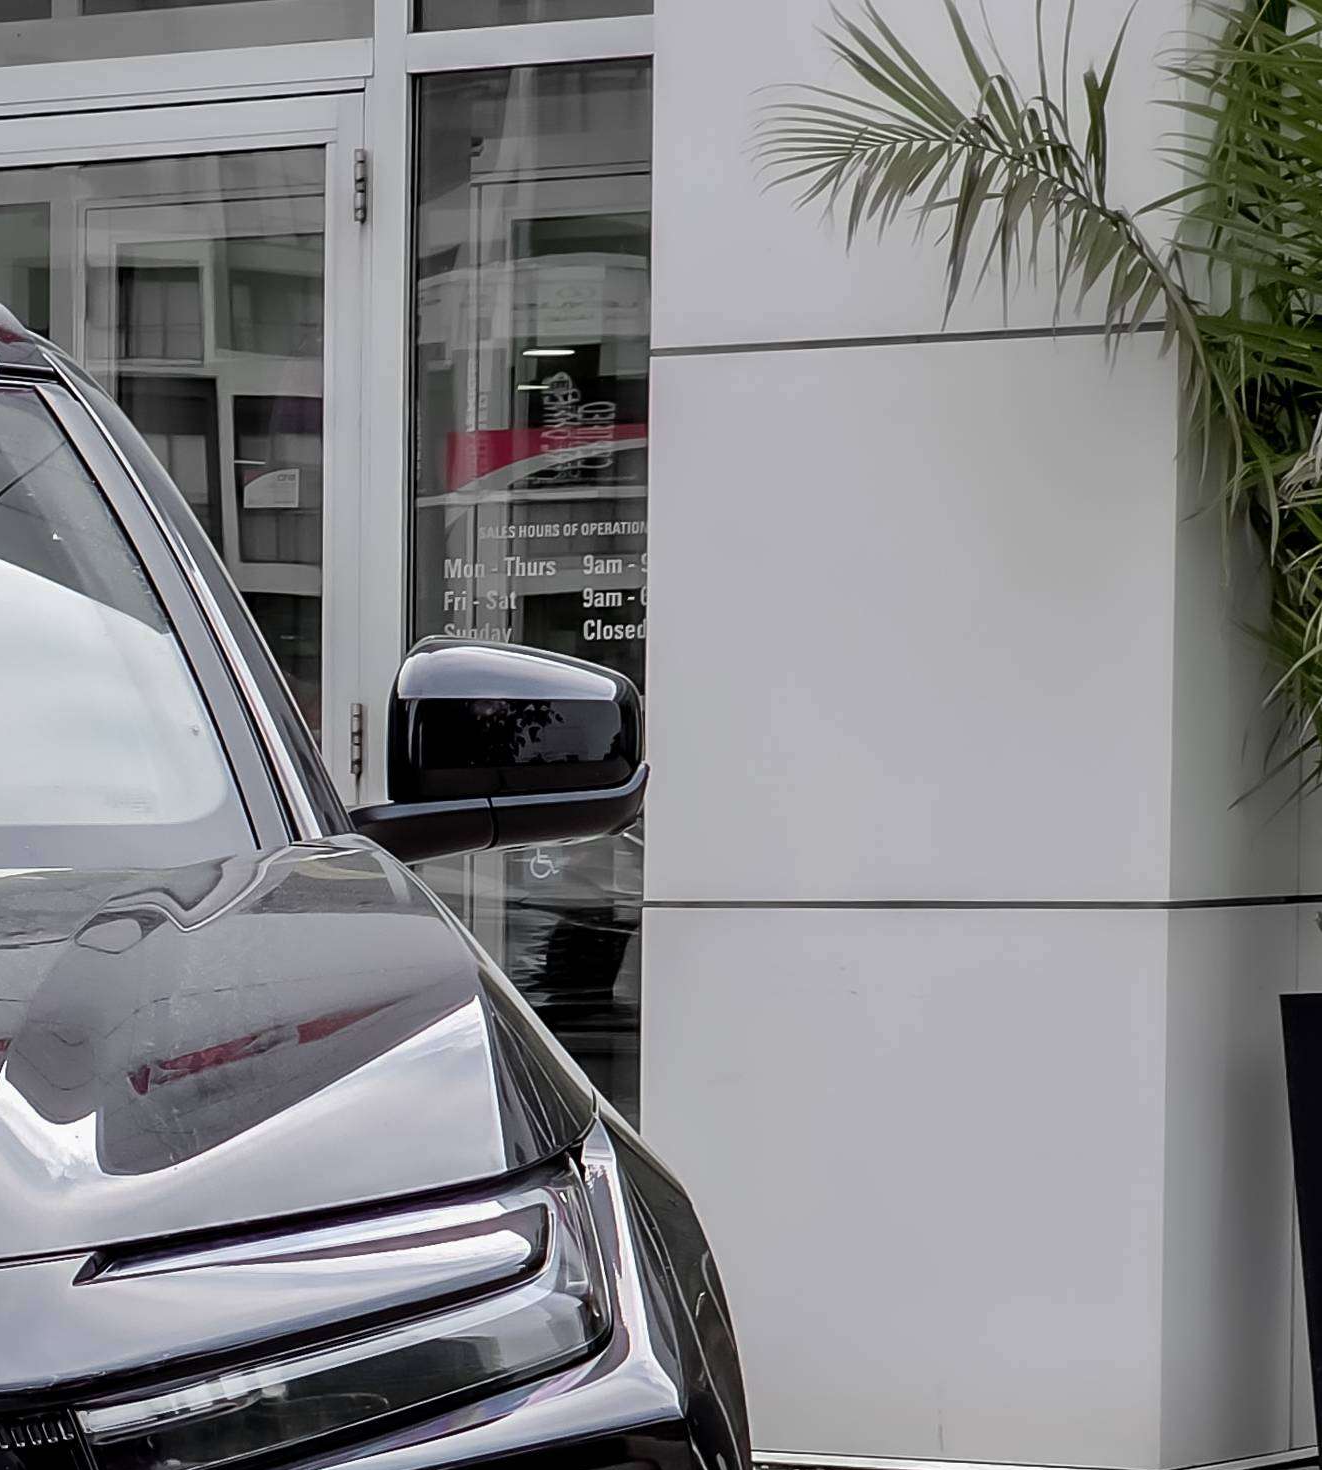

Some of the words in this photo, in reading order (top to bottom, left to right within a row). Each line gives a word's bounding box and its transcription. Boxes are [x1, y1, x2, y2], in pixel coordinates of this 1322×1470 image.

[478, 525, 516, 540] SALES
[518, 523, 560, 539] HOURS
[563, 523, 579, 537] OF
[443, 558, 486, 579] Mon
[505, 556, 556, 577] Thurs
[583, 554, 623, 575] 9am
[443, 590, 467, 611] Fri
[486, 590, 517, 610] Sat
[583, 587, 623, 608] 9am
[583, 618, 647, 641] Closed
